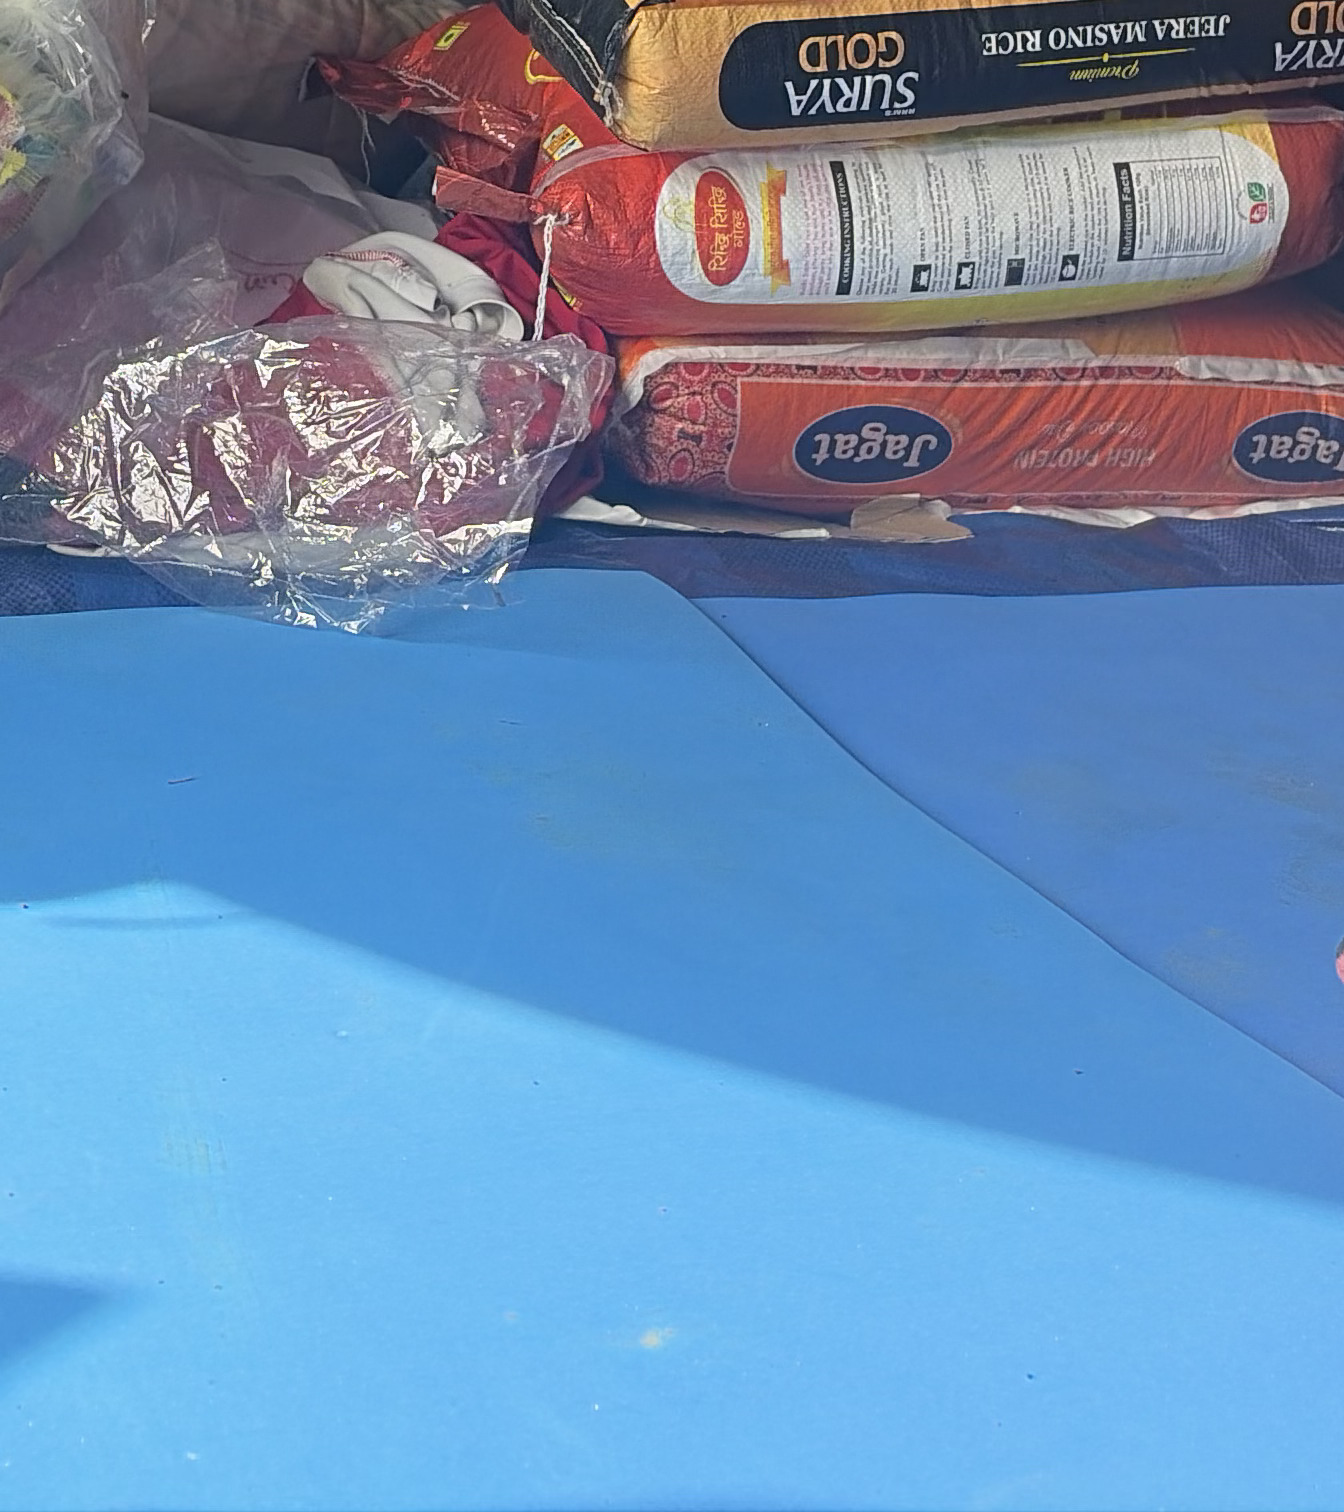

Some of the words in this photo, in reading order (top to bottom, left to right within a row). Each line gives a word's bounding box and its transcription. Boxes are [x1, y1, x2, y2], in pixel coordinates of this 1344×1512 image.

[981, 29, 1042, 56] RICE
[1048, 20, 1147, 51] MASINO
[1156, 14, 1231, 41] JEERA
[798, 31, 905, 73] GOLD
[1069, 59, 1140, 82] Premium
[784, 71, 919, 116] SURYA
[1119, 168, 1132, 202] Facts
[836, 172, 851, 239] INSTRUCTIONS
[1121, 204, 1133, 256] Nutrition
[841, 240, 851, 284] COOKING
[812, 422, 938, 468] Jagat
[1013, 447, 1099, 470] PROTEIN
[1105, 448, 1156, 468] HIGH
